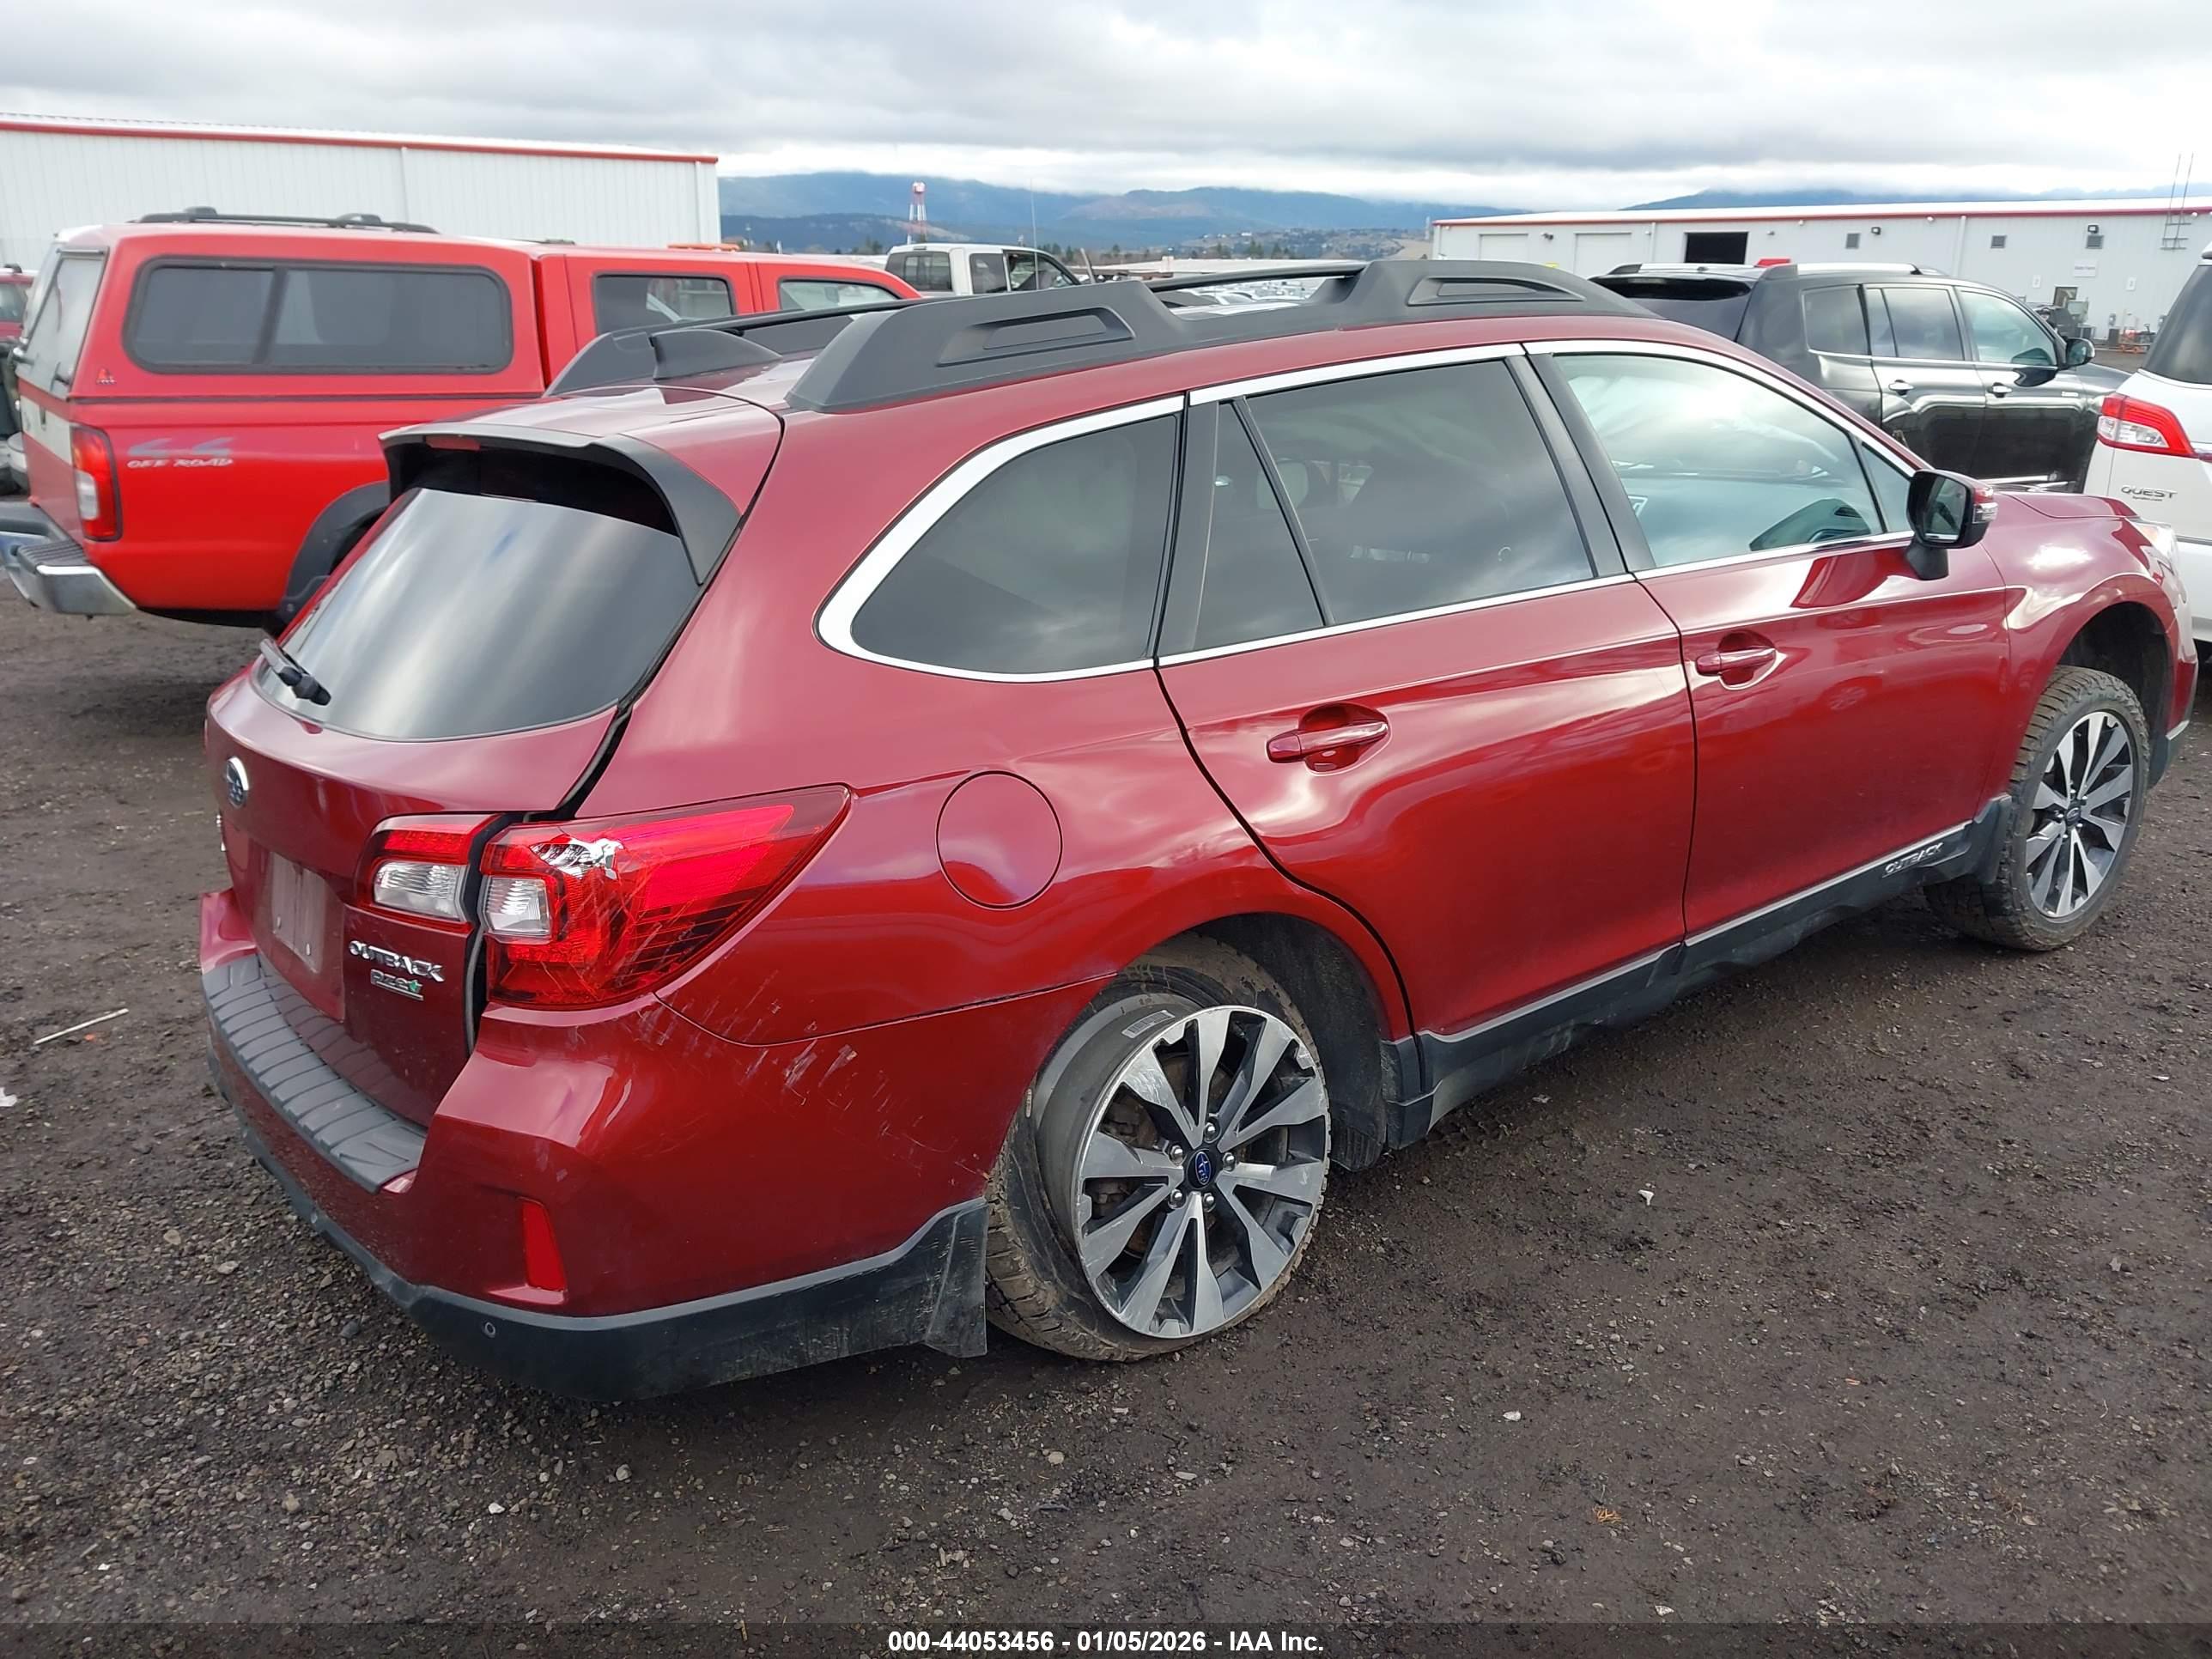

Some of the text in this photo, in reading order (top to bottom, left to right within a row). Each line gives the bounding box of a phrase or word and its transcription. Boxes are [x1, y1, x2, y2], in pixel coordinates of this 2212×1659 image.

[126, 459, 234, 468] OFF ROAD
[2121, 485, 2178, 499] QUEST
[1885, 842, 1944, 873] OUTBACK
[349, 940, 445, 981] OUTBACK
